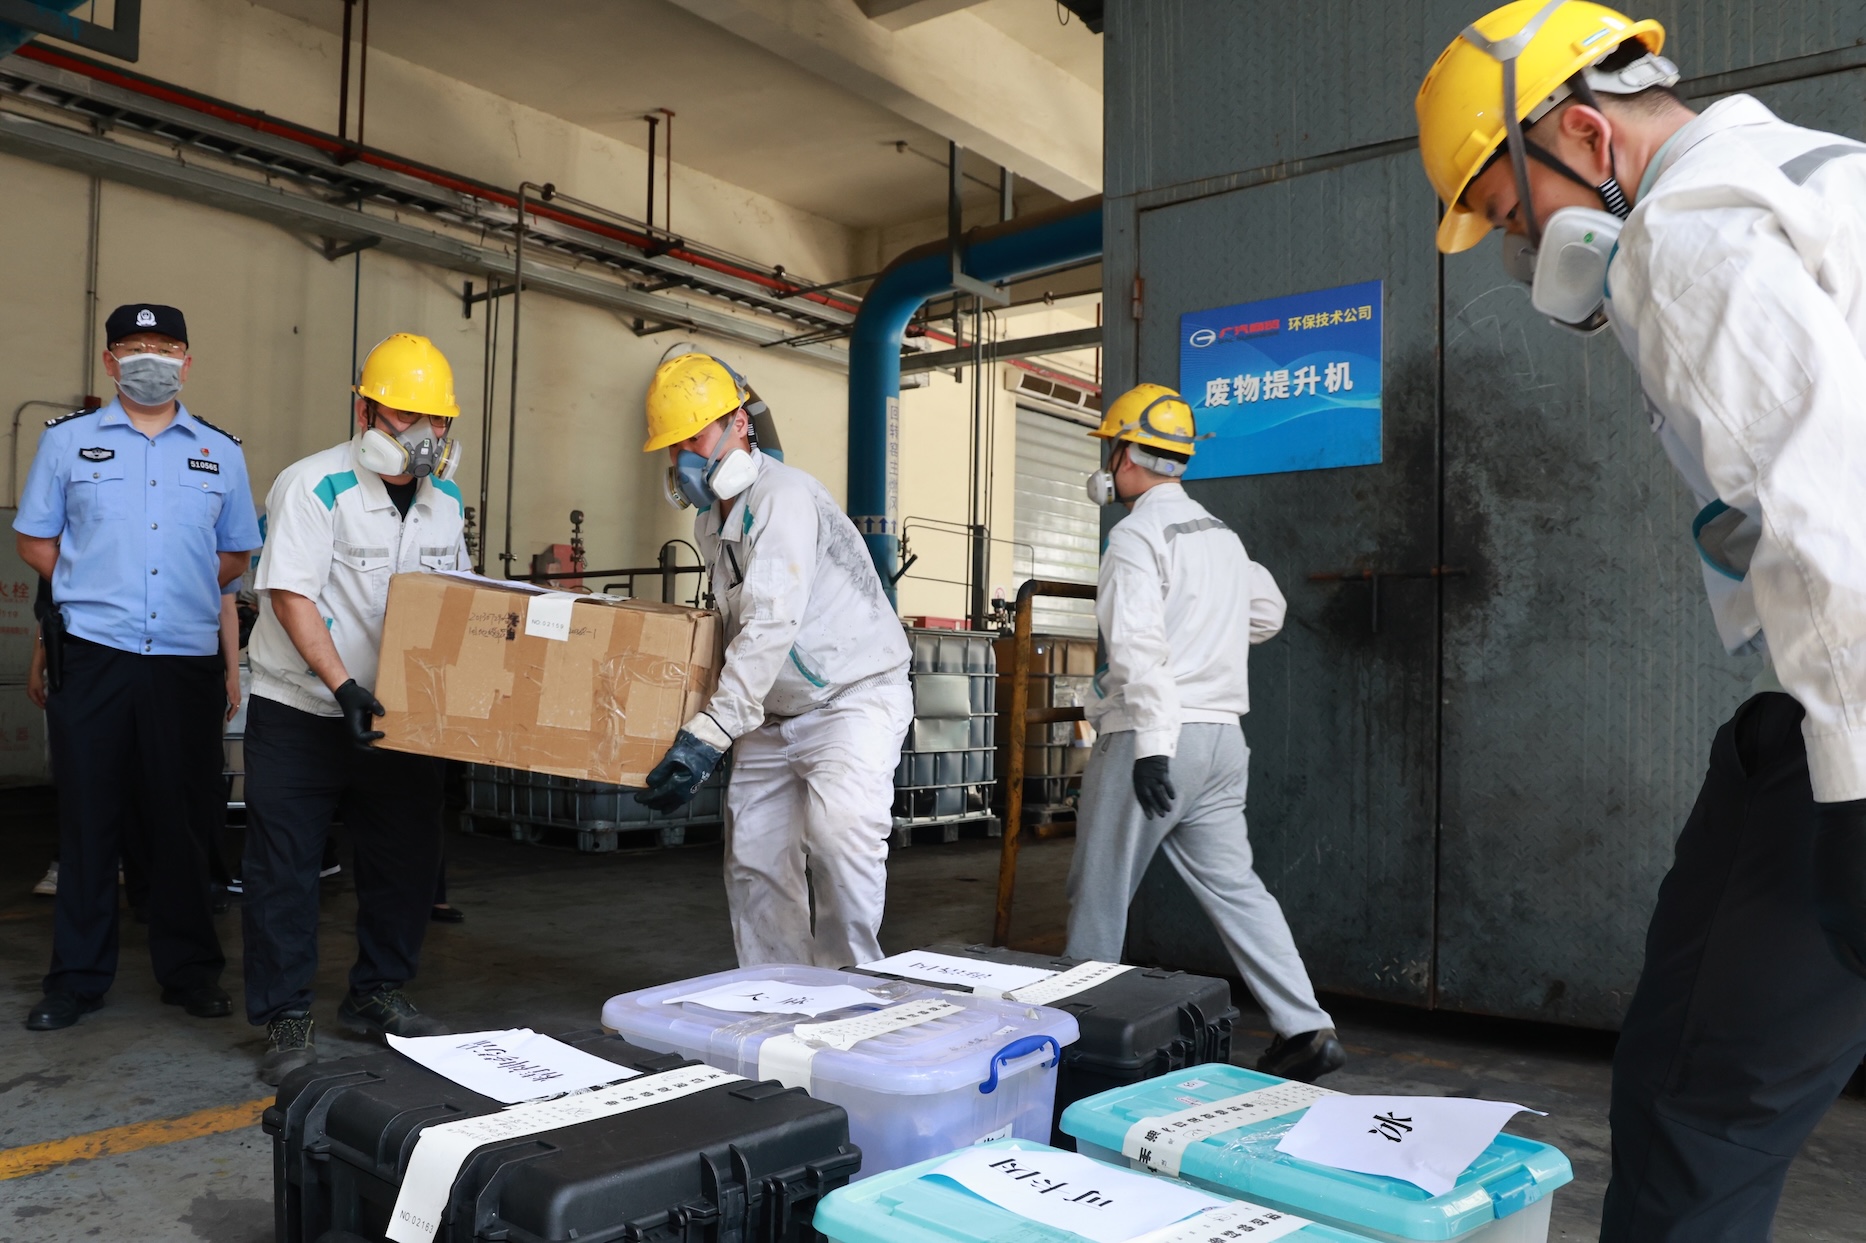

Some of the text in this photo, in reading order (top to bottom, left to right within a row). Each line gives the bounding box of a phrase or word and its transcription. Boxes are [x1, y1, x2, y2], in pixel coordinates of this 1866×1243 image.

[1288, 305, 1372, 332] 环保技术公司
[1204, 361, 1354, 408] 废物提升机
[1367, 1111, 1413, 1143] 冰
[988, 1158, 1114, 1212] 可卡因
